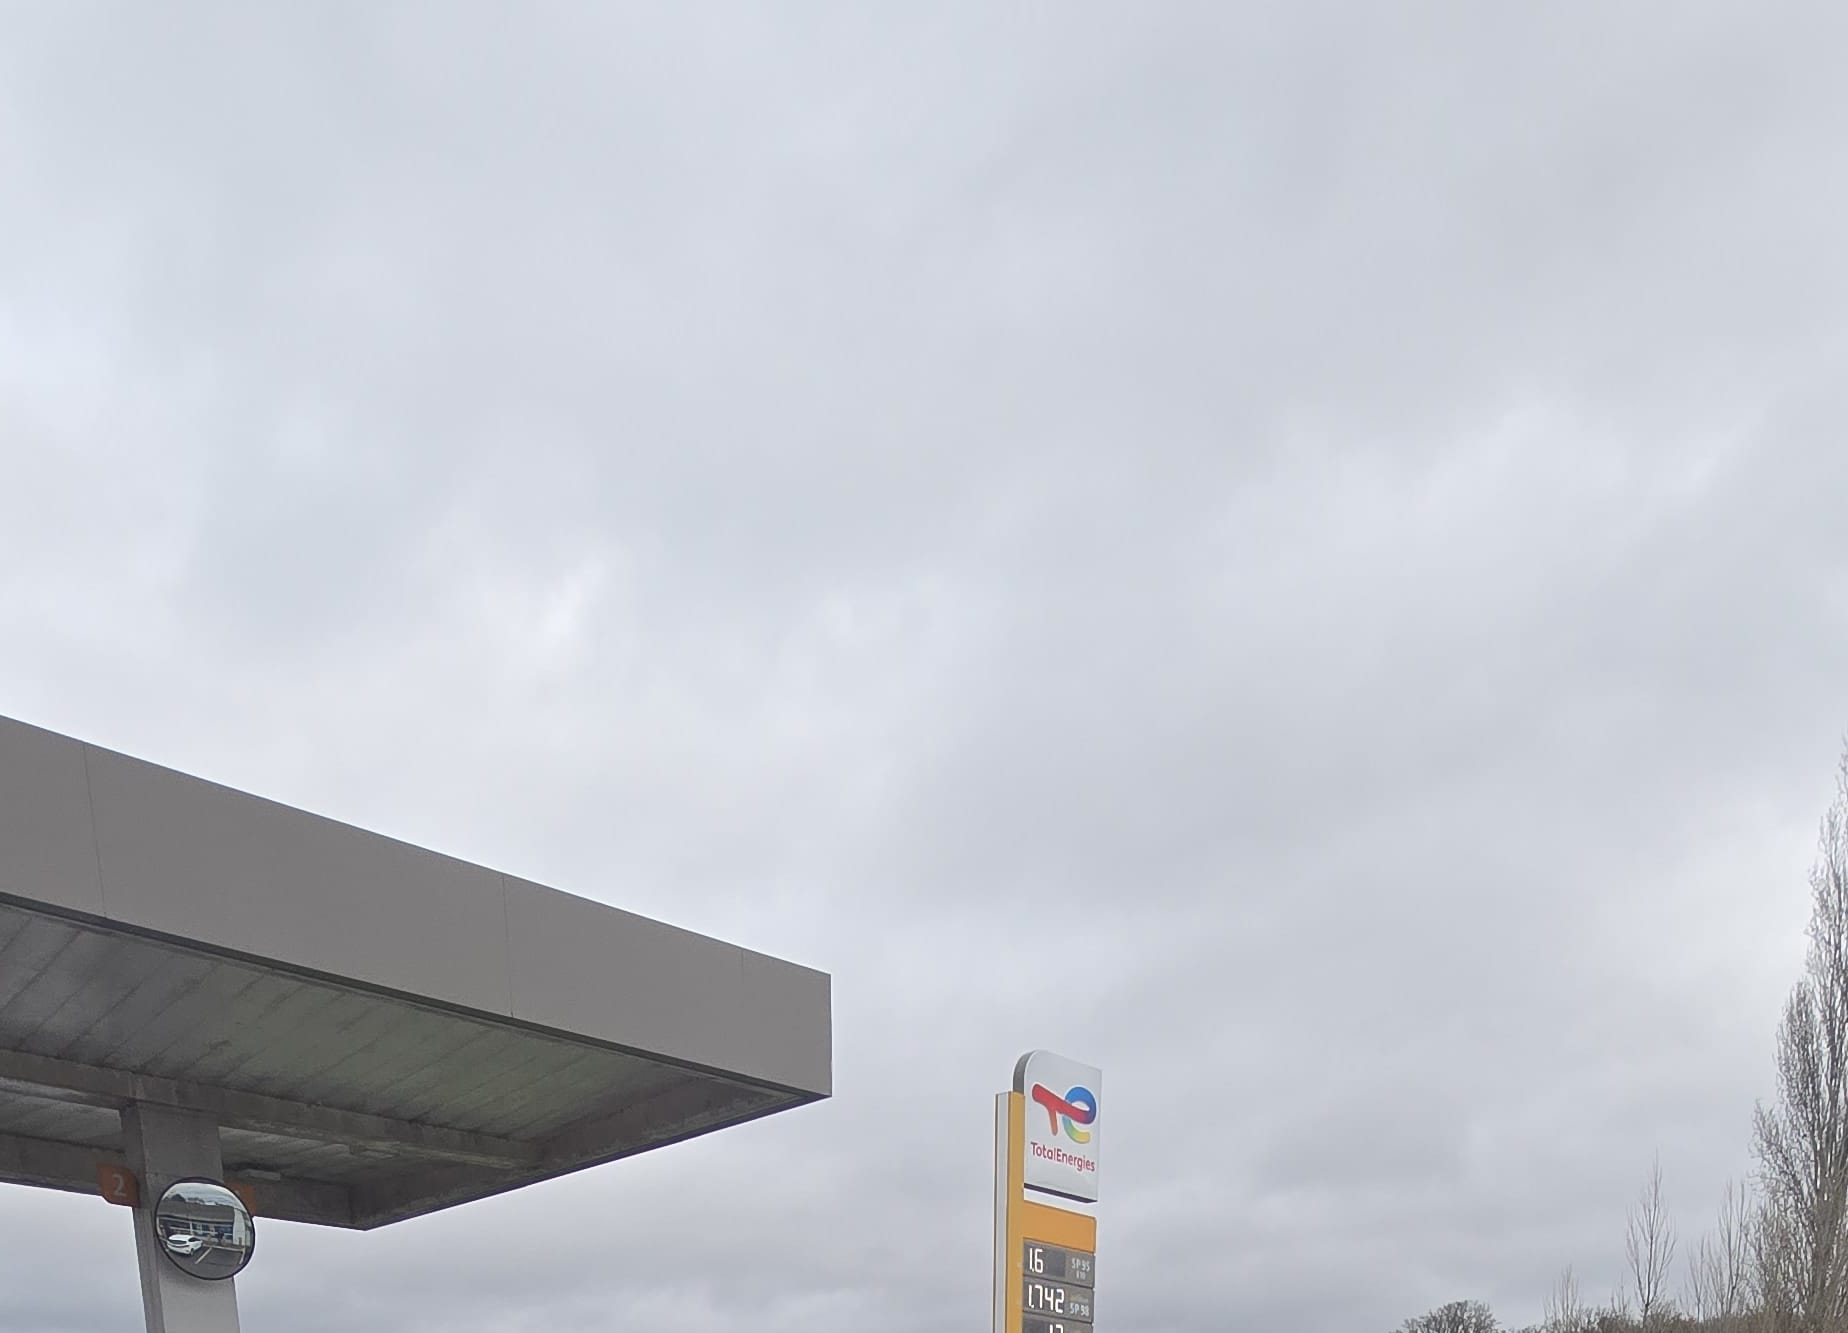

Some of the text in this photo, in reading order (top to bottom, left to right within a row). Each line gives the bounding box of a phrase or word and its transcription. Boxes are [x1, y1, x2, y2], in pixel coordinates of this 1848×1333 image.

[1030, 1141, 1095, 1172] TotalEnergies
[1028, 1284, 1065, 1314] 1.742
[1069, 1302, 1090, 1318] SP 98
